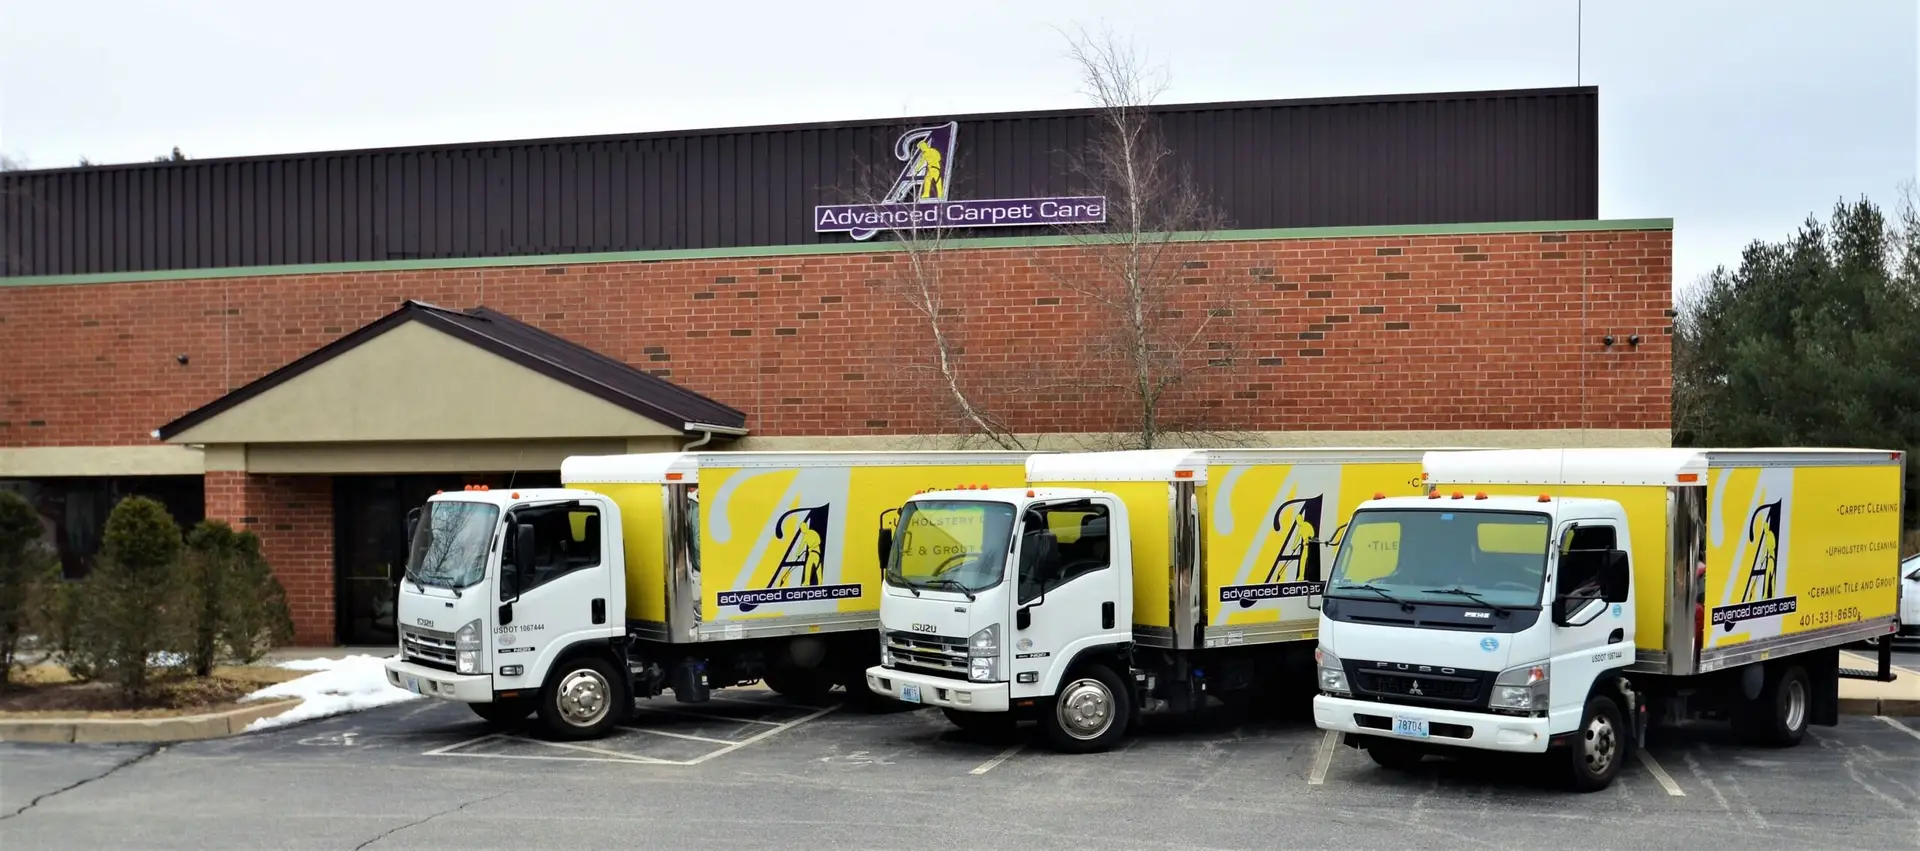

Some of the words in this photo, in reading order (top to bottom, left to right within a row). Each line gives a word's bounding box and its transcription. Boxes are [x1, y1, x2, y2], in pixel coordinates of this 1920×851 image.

[819, 201, 938, 226] Advanced
[946, 202, 1033, 223] Carpet
[1040, 200, 1102, 218] Care
[932, 544, 975, 556] GROUT
[1373, 540, 1398, 552] TILE
[720, 590, 782, 605] advanced
[786, 588, 828, 600] carpet
[831, 586, 859, 597] care
[1222, 585, 1279, 600] advanced
[1282, 584, 1321, 597] carpet
[1713, 606, 1751, 622] advanced
[1752, 602, 1778, 617] carpet
[1778, 599, 1796, 612] care
[1799, 606, 1858, 627] 401-331-8650
[493, 625, 518, 635] USDOT
[519, 623, 545, 633] 1067444
[911, 622, 937, 634] ISUZU
[1376, 661, 1456, 675] FUSO
[1397, 719, 1423, 733] 78704
